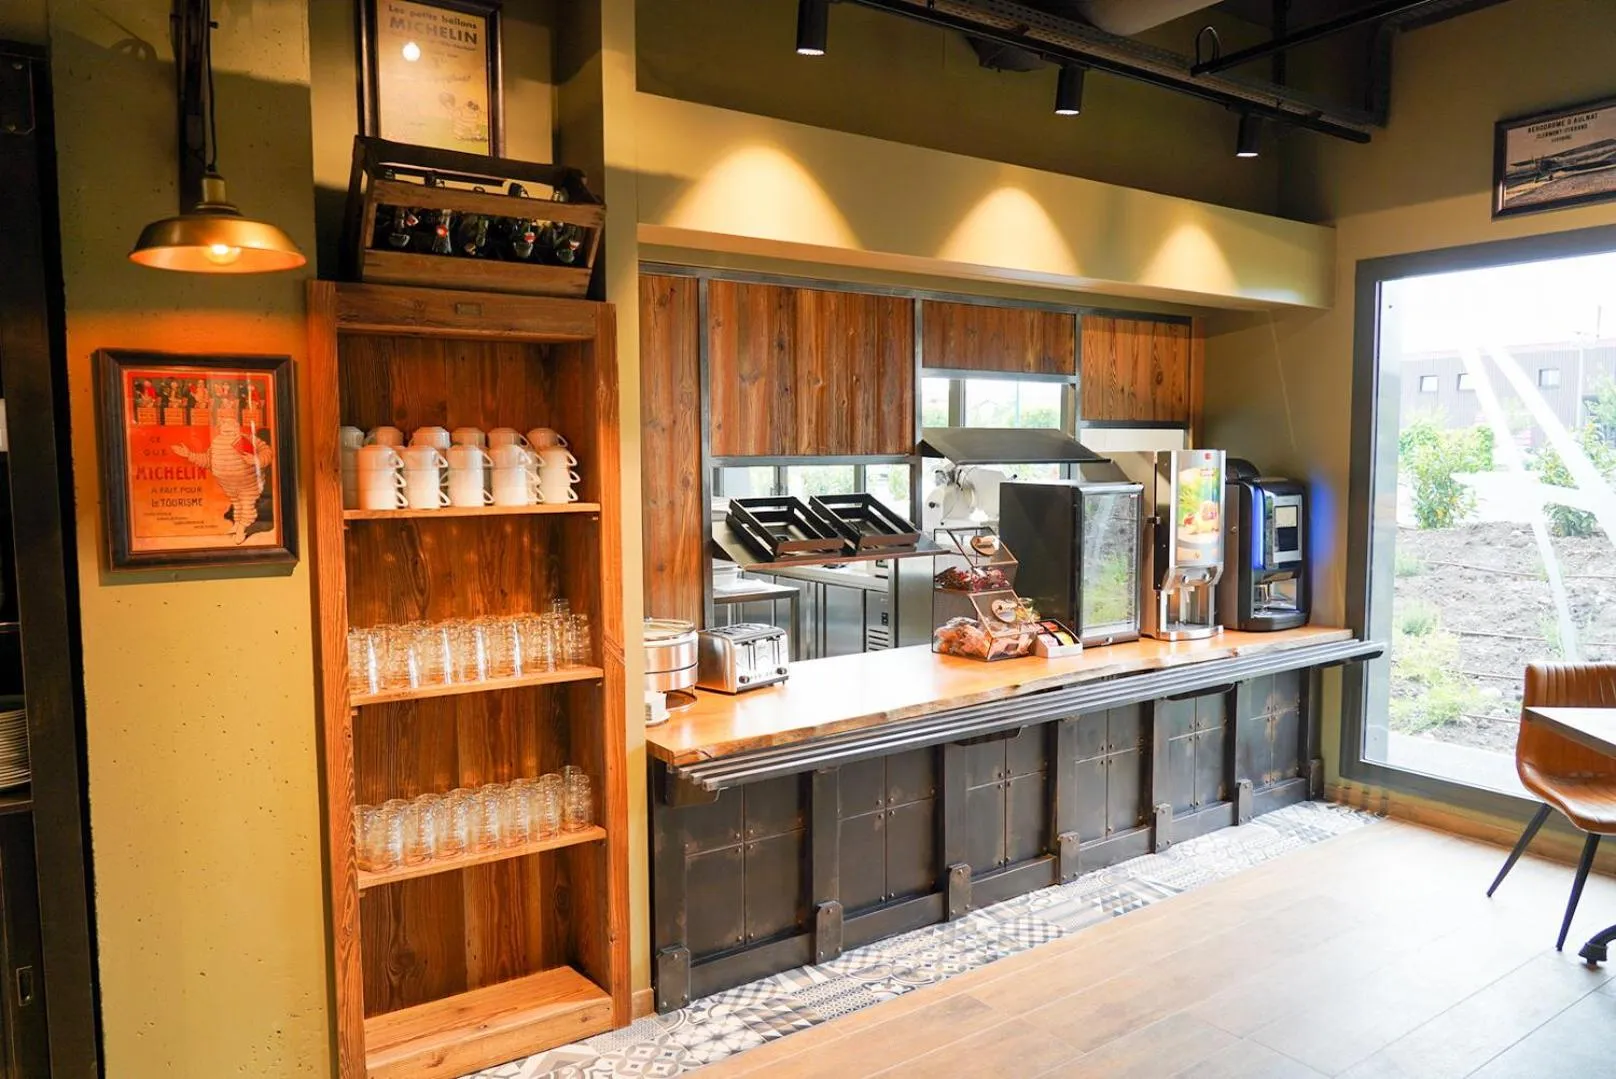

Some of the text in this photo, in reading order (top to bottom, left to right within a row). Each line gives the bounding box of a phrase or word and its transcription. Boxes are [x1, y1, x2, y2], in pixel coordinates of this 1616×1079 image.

[441, 14, 477, 29] ballons
[389, 16, 477, 45] MICHELIN
[135, 465, 207, 481] MICHELIN
[159, 486, 178, 494] FAIT
[180, 486, 202, 494] POUR
[159, 498, 203, 508] TOURISME
